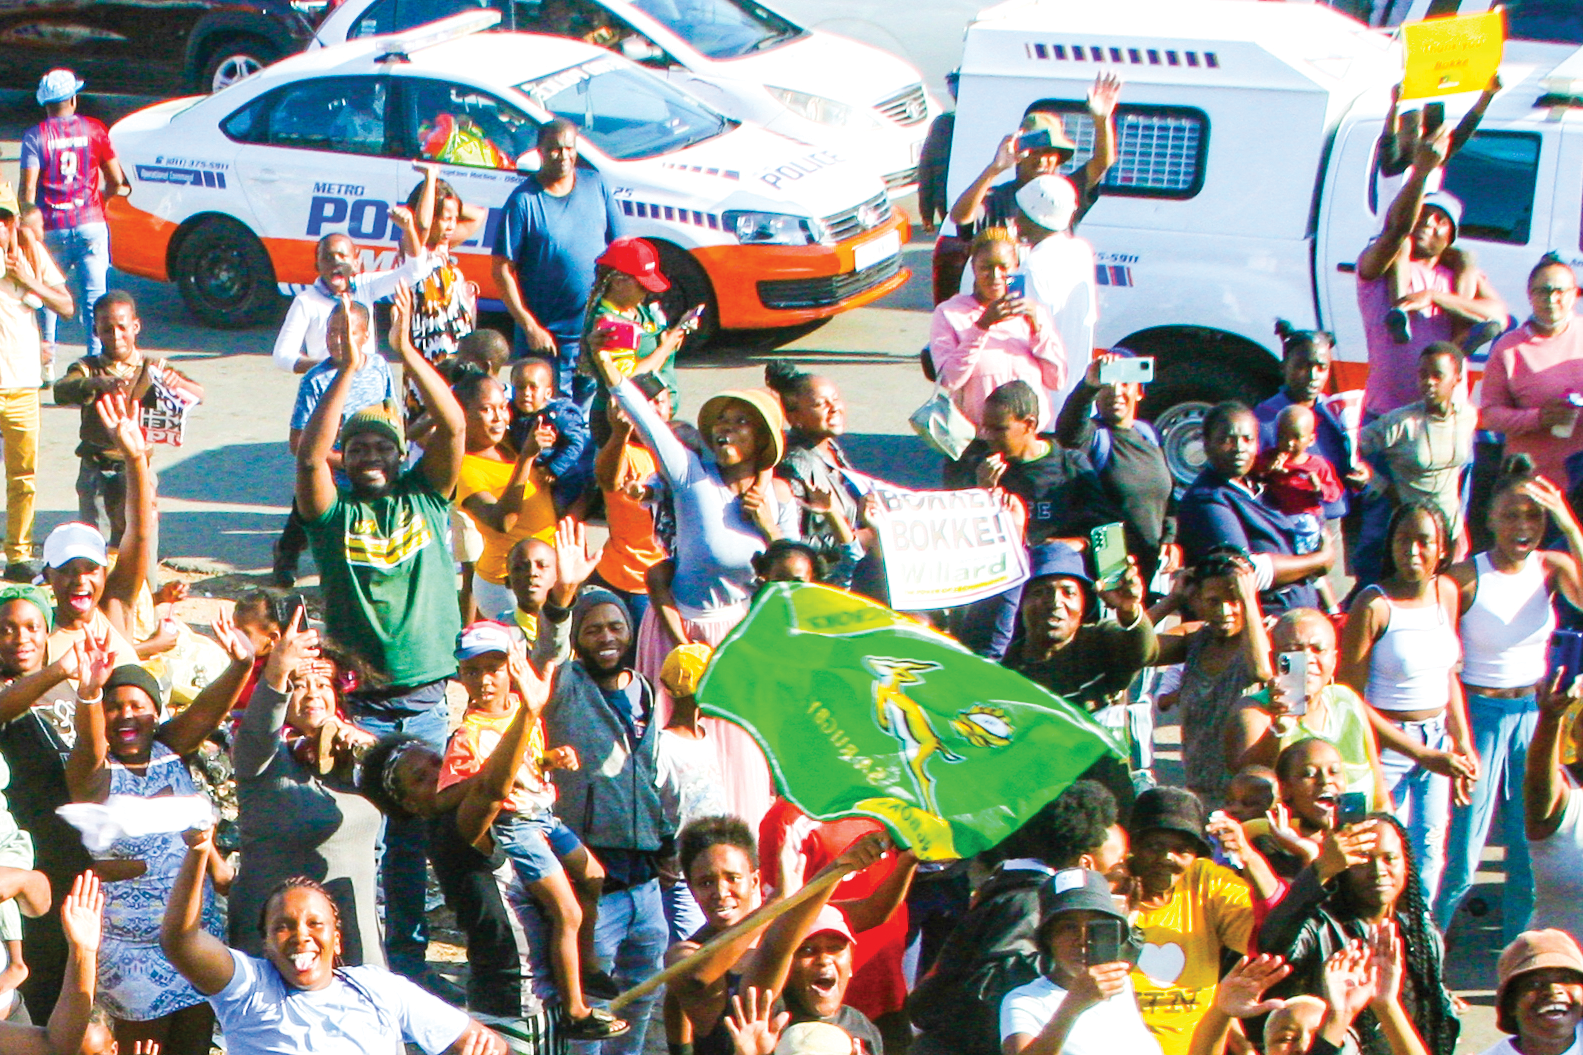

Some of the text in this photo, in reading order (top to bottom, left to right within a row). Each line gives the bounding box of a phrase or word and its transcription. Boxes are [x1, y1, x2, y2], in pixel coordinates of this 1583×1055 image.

[313, 181, 364, 196] METRO
[760, 150, 847, 191] POLICE
[891, 514, 1006, 551] BOKKE!
